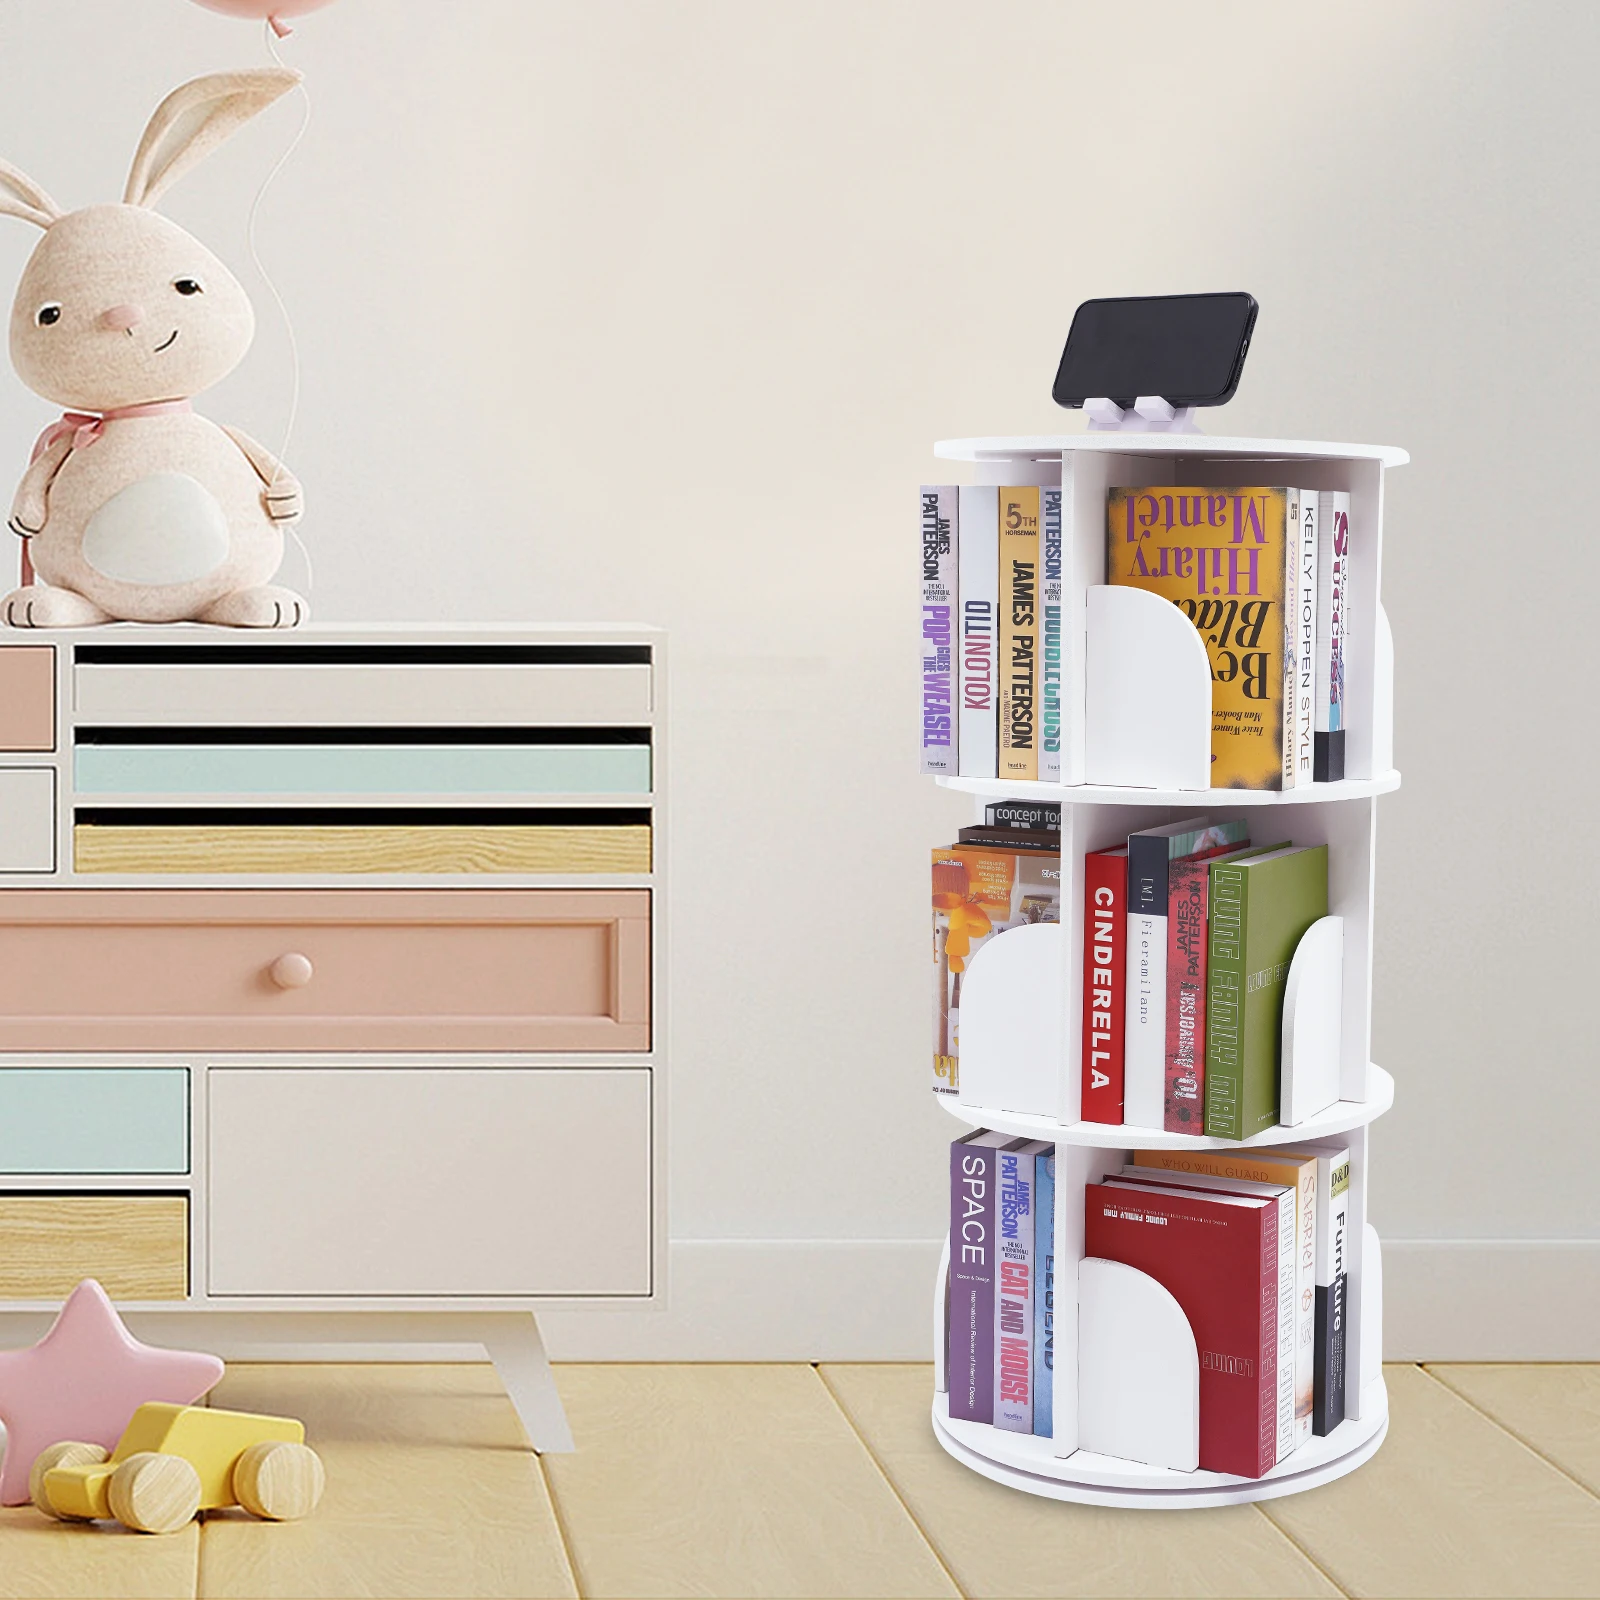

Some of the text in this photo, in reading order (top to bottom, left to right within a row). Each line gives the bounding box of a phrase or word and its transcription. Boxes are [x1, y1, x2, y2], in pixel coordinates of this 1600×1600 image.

[922, 493, 939, 581] PATTERSON
[939, 518, 950, 555] JAMES
[1005, 502, 1037, 529] 5TH
[1045, 491, 1061, 580] PATTERSON
[1124, 495, 1270, 544] Mantel
[1127, 530, 1262, 596] Hilary
[1301, 508, 1314, 771] KELLY HOPPEN STYLE
[1331, 511, 1348, 705] SUCCESS
[922, 605, 950, 748] POP GOES THE WEASEL
[965, 600, 991, 710] KOLONITID
[1011, 560, 1034, 749] JAMES PATTERSON
[1212, 725, 1240, 735] Winner
[1215, 711, 1243, 721] Booker
[1244, 712, 1262, 722] Man
[996, 808, 1041, 823] concept
[1176, 900, 1189, 956] JAMES
[1187, 880, 1202, 977] PATTERSON
[1091, 886, 1114, 1089] CINDERELLA
[1140, 920, 1152, 1024] Fieramilano
[1173, 981, 1199, 1069] Anniversary
[1002, 1155, 1018, 1239] PATTERSON
[1018, 1180, 1029, 1216] JAMES
[1161, 1158, 1269, 1182] WHO WILL GUARD
[1332, 1165, 1349, 1187] D&D
[962, 1155, 986, 1265] SPACE
[1104, 1208, 1118, 1218] MAN
[1120, 1211, 1143, 1221] FAMILY
[1145, 1214, 1168, 1226] LOVING
[1334, 1211, 1344, 1331] Furniture
[1001, 1261, 1029, 1405] CAT AND MOUSE
